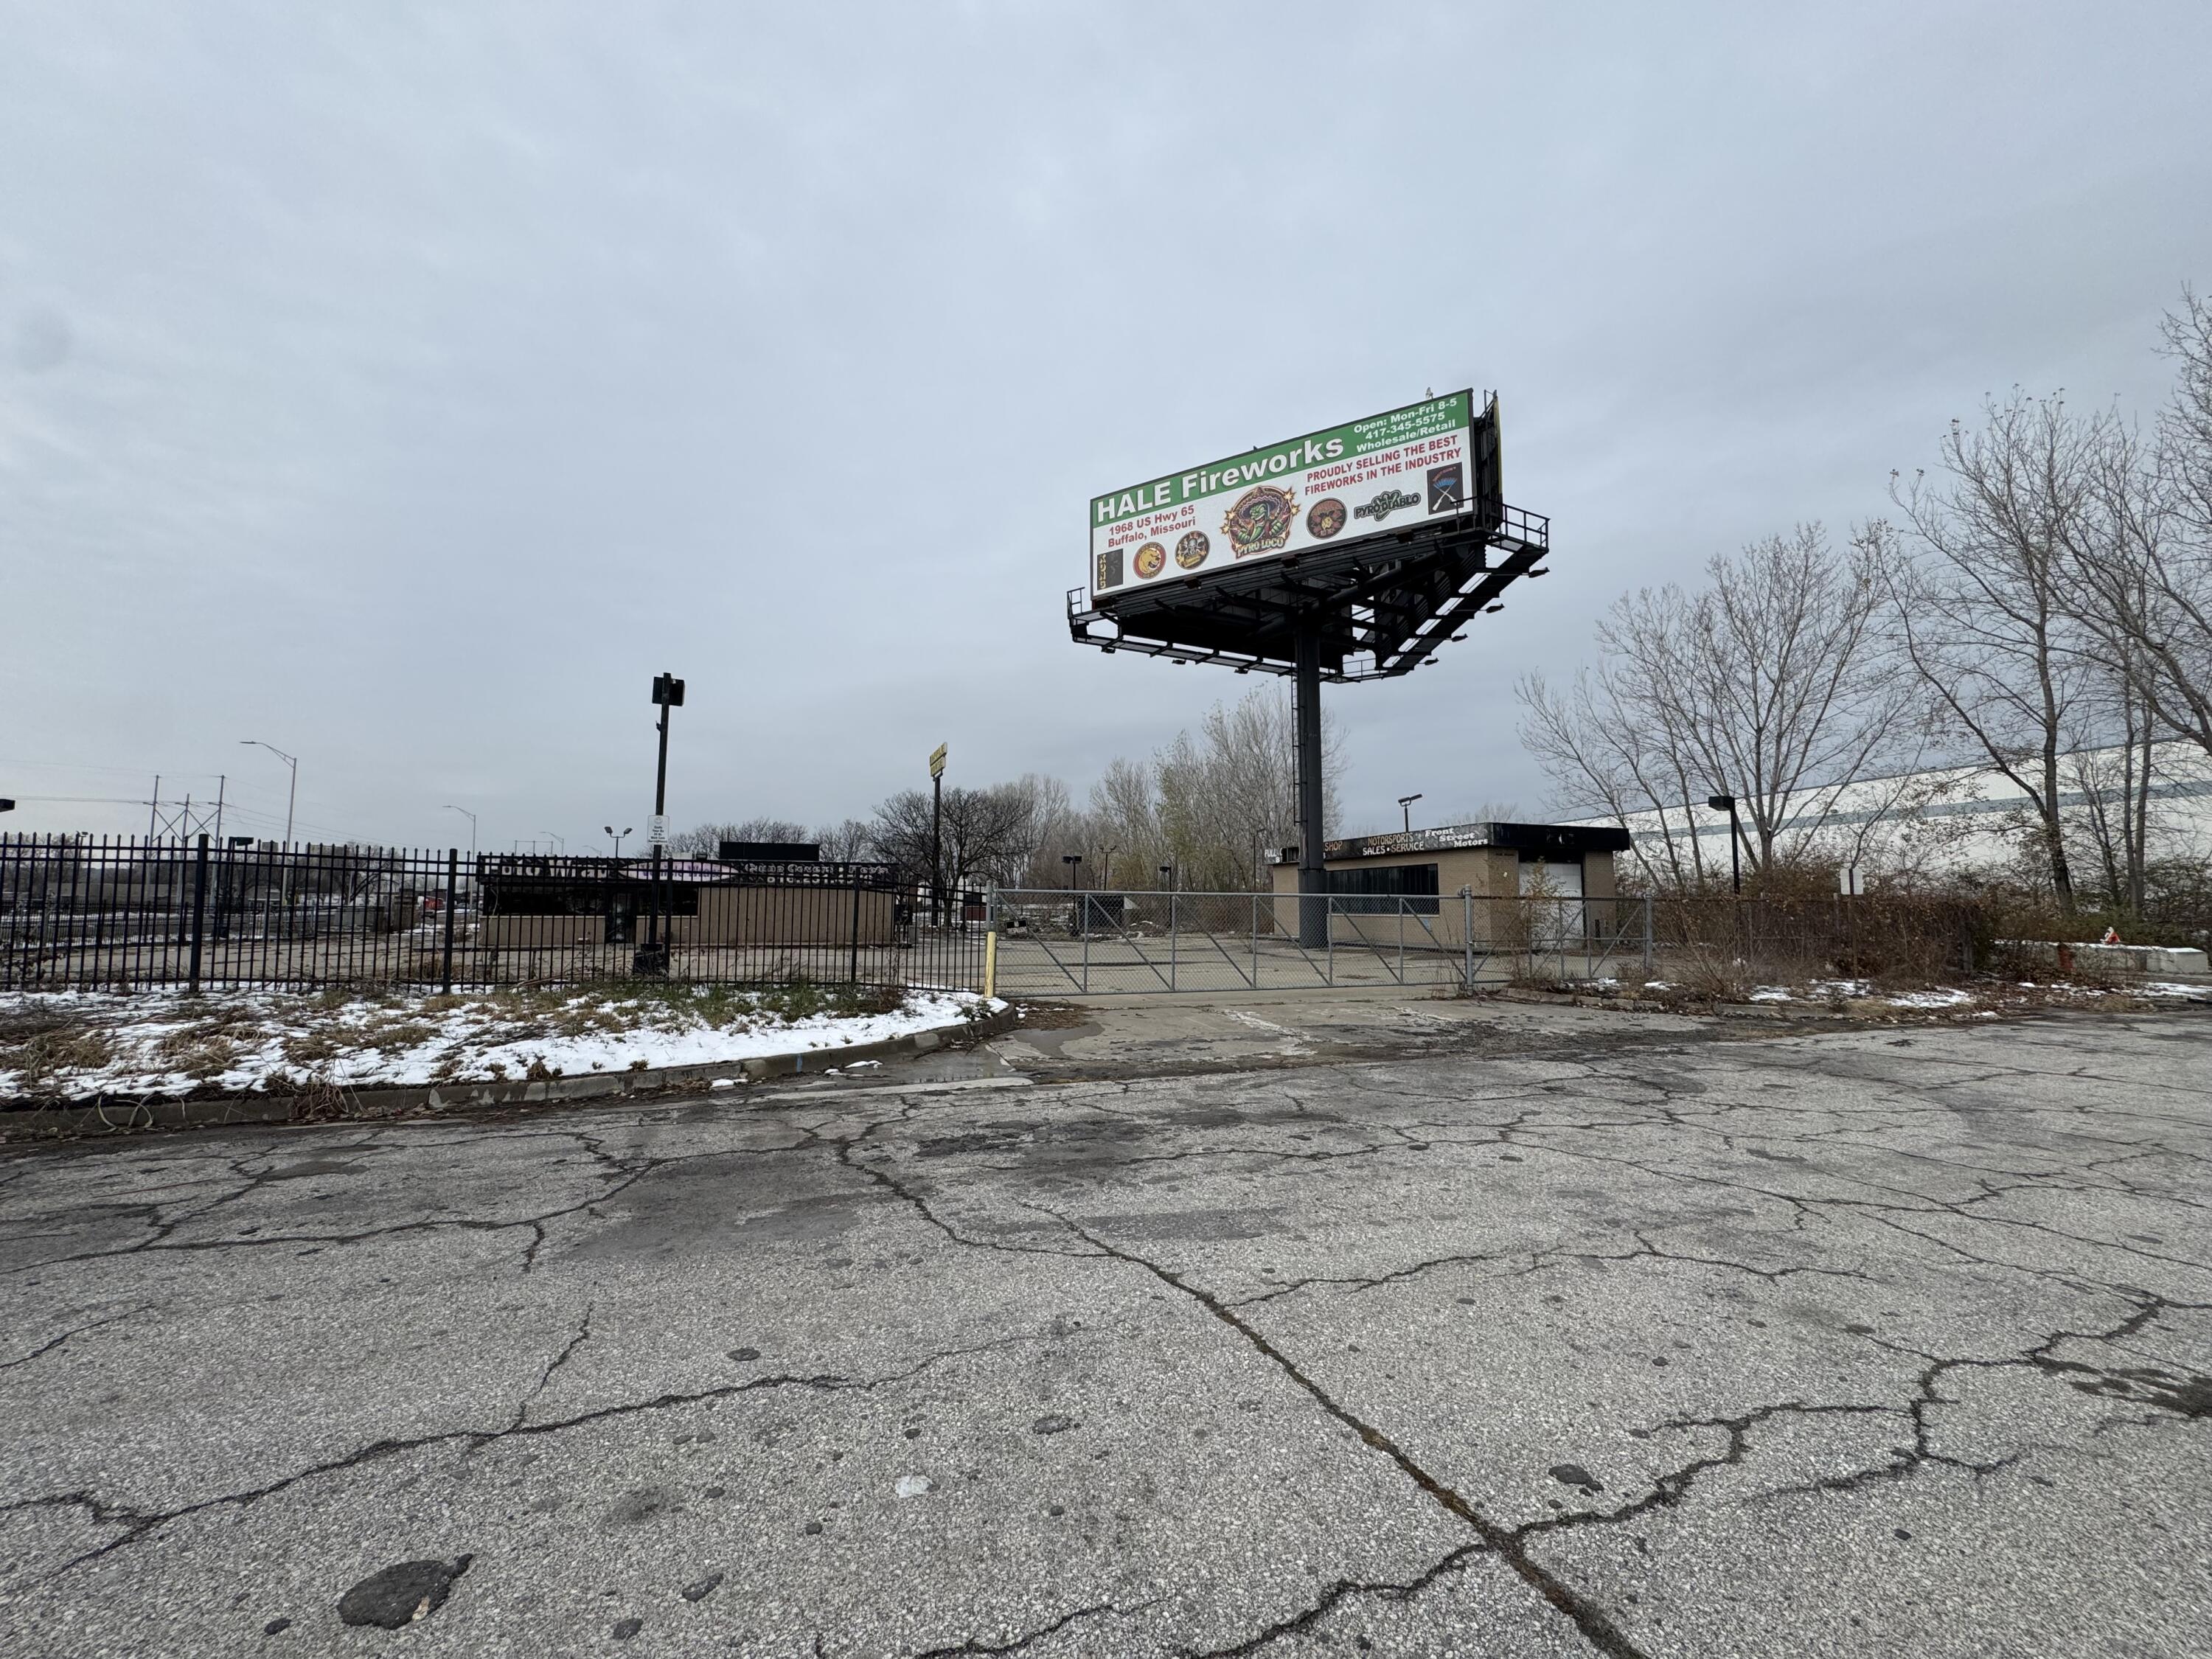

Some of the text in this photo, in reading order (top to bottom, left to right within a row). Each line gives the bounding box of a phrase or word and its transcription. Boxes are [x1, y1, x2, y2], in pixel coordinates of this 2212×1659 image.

[1354, 398, 1457, 434] Open: Mon-Fri 8-5
[1366, 411, 1445, 439] 417-345-5575
[1356, 419, 1455, 453] Wholesale/Retail
[1304, 448, 1461, 495] FIREWORKS IN THE INDUSTRY
[1307, 435, 1458, 482] PROUDLY SELLING THE BEST
[1098, 437, 1344, 522] HALE Fireworks
[1355, 494, 1420, 518] PYRO DIABLO
[1108, 516, 1195, 547] Buffalo, Missouri
[1109, 504, 1194, 535] 1968 US Hwy 65
[1237, 537, 1284, 557] PYRO LOCO
[1368, 832, 1413, 846] MOTORSPORTS
[1425, 827, 1454, 838] Front
[1439, 832, 1475, 842] Street
[1453, 839, 1488, 848] Motors
[1265, 849, 1277, 858] FULL
[1324, 841, 1343, 852] SHOP
[1363, 841, 1425, 855] SALES SERVICE
